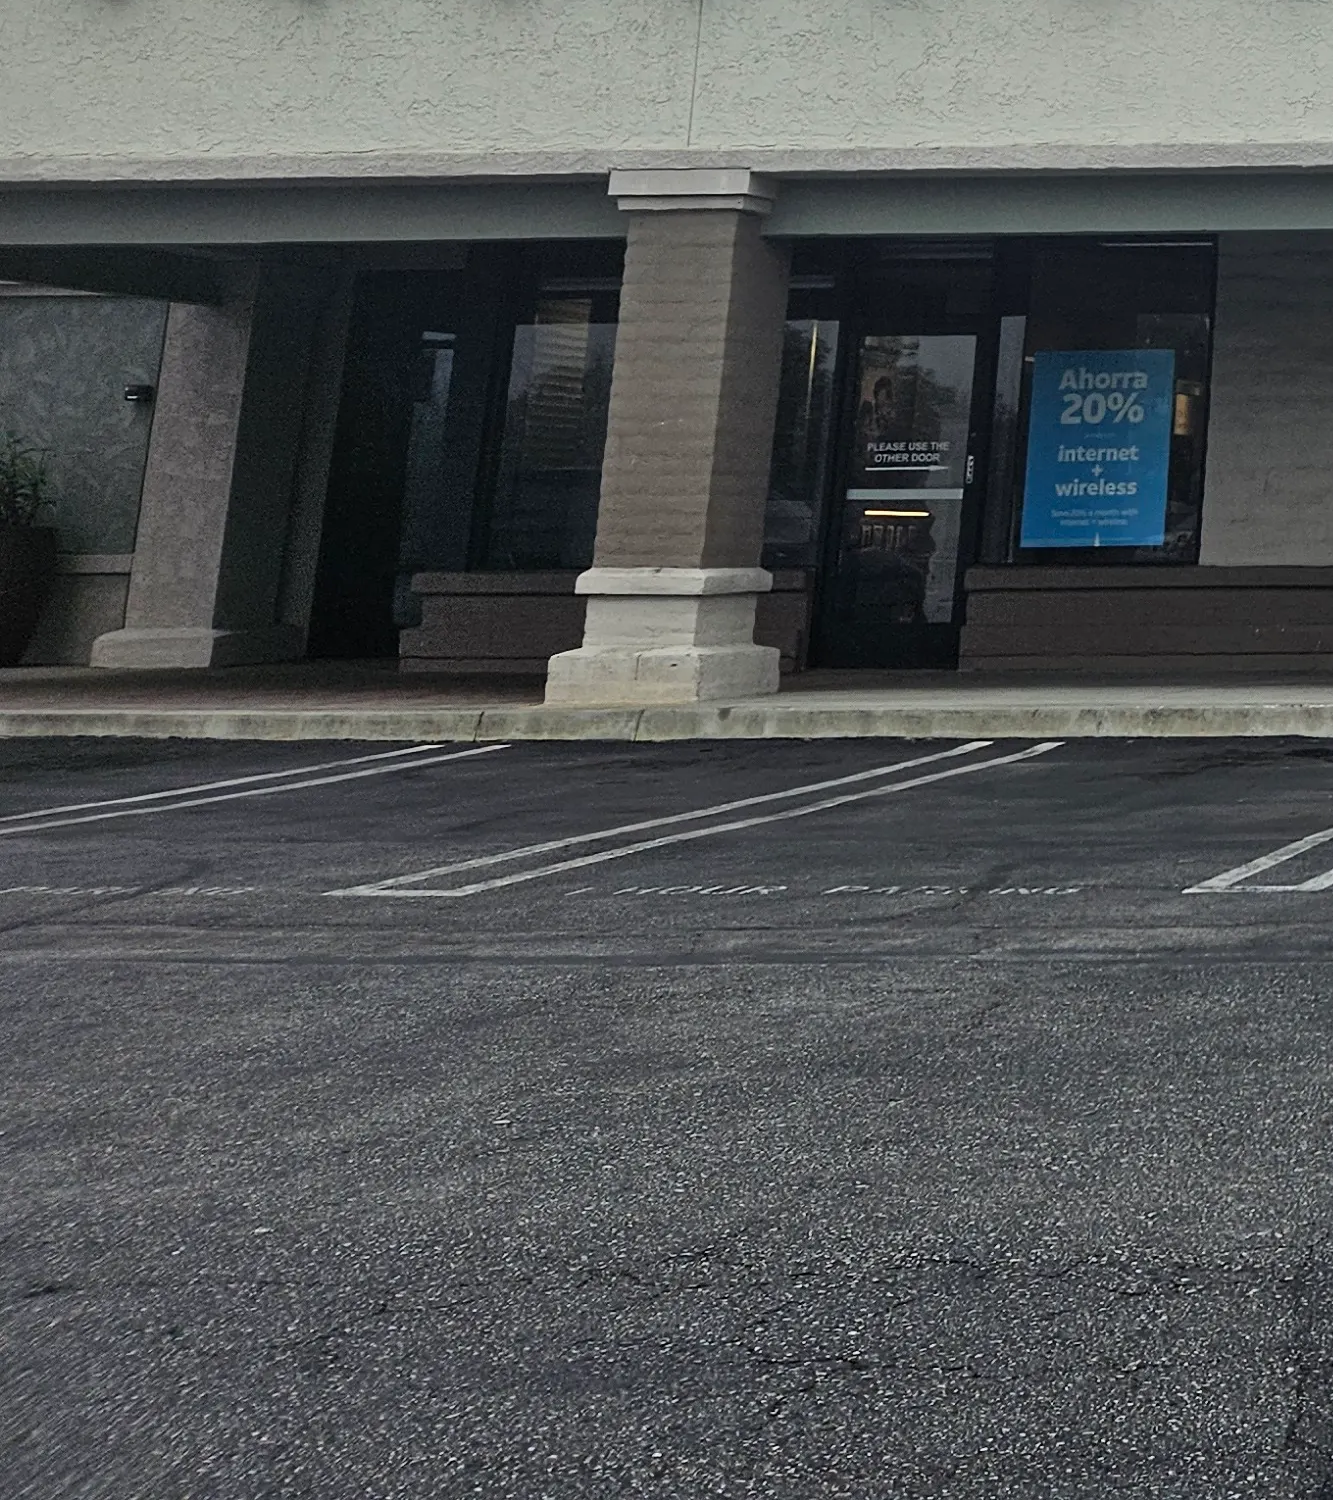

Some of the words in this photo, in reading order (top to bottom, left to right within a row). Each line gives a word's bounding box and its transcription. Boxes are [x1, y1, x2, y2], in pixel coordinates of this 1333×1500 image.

[1058, 367, 1149, 391] Ahorra
[1060, 391, 1145, 425] 20%
[867, 442, 905, 451] PLEASE
[908, 442, 928, 451] USE
[930, 441, 950, 450] THE
[1057, 444, 1140, 462] internet
[874, 453, 909, 463] OTHER
[911, 453, 941, 462] DOOR
[1055, 479, 1138, 497] wireless
